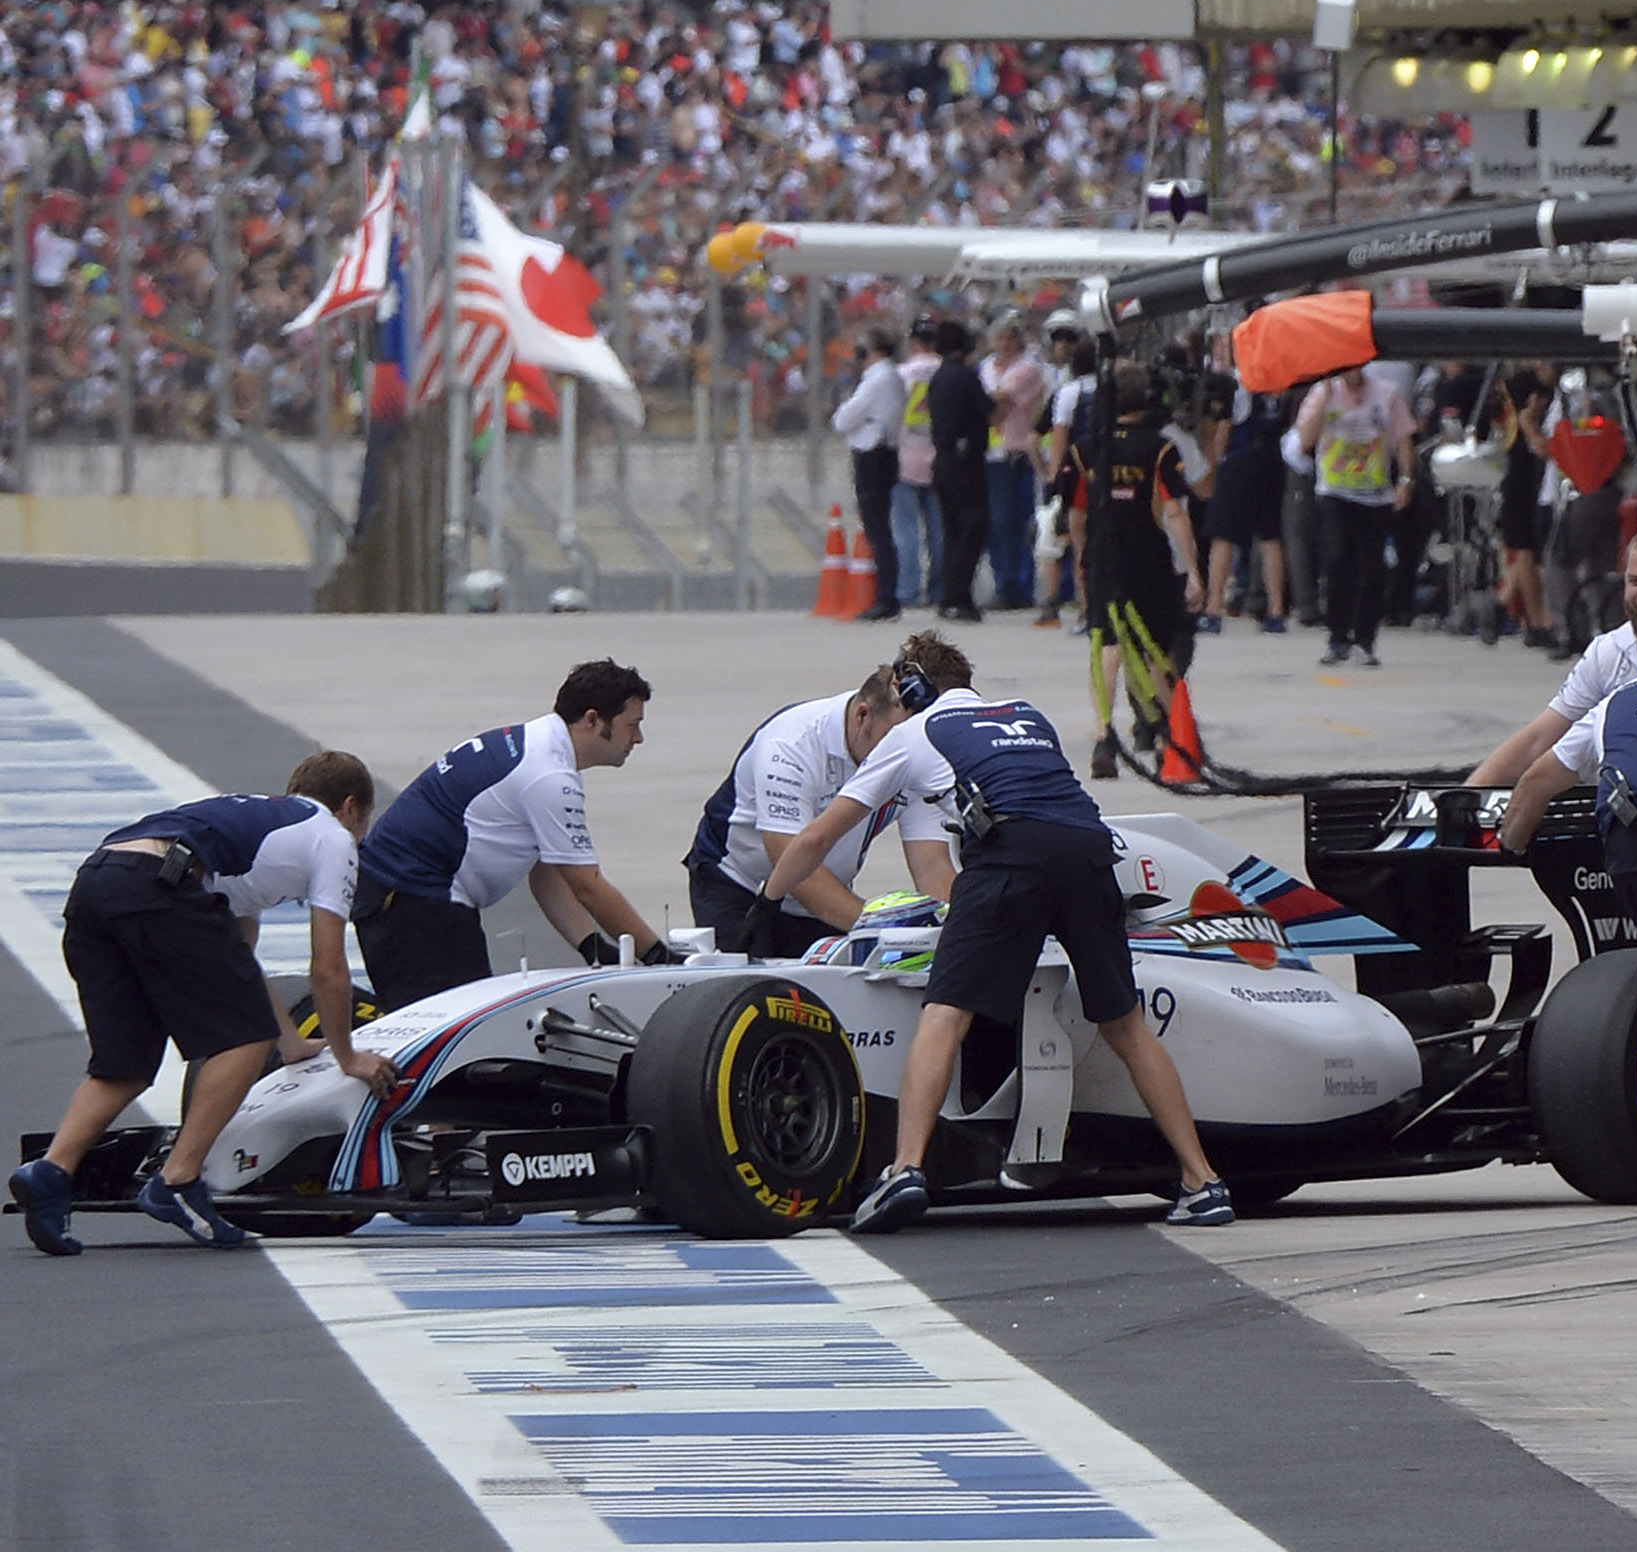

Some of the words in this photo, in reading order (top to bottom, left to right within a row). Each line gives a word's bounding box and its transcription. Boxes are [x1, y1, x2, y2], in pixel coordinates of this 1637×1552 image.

[1582, 105, 1618, 146] 2
[991, 736, 1054, 748] randstad
[1140, 859, 1159, 892] E
[1169, 915, 1286, 947] MARTINI
[1137, 986, 1177, 1038] 19
[525, 1152, 595, 1180] KEMPPI
[735, 1161, 819, 1219] ZERO
